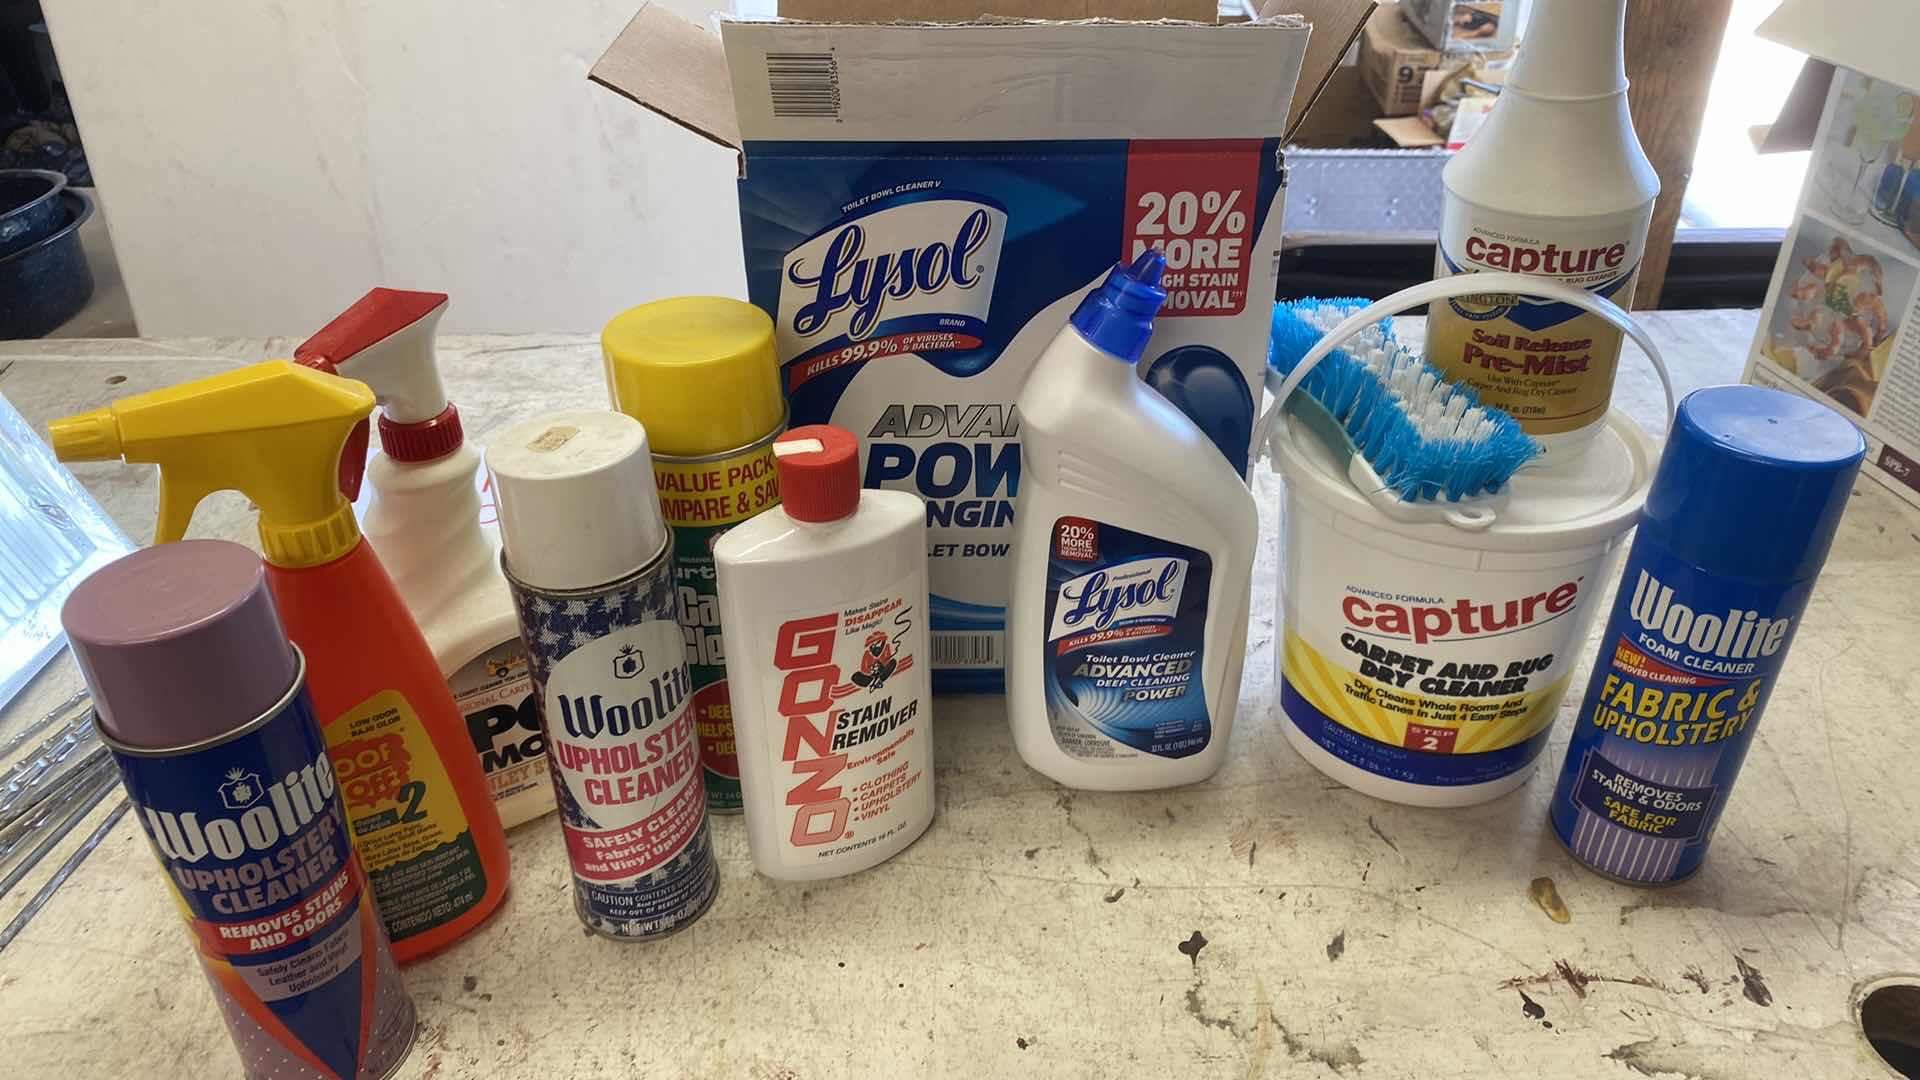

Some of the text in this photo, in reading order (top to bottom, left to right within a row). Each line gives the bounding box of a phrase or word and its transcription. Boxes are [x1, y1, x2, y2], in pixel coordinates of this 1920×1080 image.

[842, 195, 870, 213] TOILET
[871, 187, 894, 201] BOWL
[895, 180, 934, 194] CLEANER
[1135, 189, 1247, 236] 20%
[1465, 236, 1627, 274] capture
[788, 208, 992, 341] Lysol
[1188, 272, 1239, 288] STAIN
[903, 333, 954, 344] OF VIRUSES
[939, 318, 966, 328] BRAND
[1472, 327, 1593, 353] Soil Release
[807, 339, 898, 376] KILLS 99.9%
[1461, 342, 1591, 376] Pre-Mist
[654, 453, 774, 493] VALUE PACK
[863, 442, 1022, 499] POW
[659, 477, 779, 522] MPARE & SAV
[926, 500, 1015, 529] NGIN
[1060, 525, 1095, 541] 20%
[1060, 538, 1093, 549] MORE
[962, 543, 1011, 558] BOW
[843, 598, 889, 618] Makes Stains
[1063, 560, 1179, 630] Lysol
[1345, 584, 1445, 605] ADVANCED FORMULA
[844, 598, 904, 628] DISAPPEAR
[845, 618, 884, 636] Like Magic!
[1342, 581, 1578, 645] capture
[1630, 568, 1790, 660] Woolite
[1068, 629, 1125, 647] KILLS 99.9%
[1638, 632, 1756, 675] FOAM CLEANER
[1072, 659, 1193, 679] ADVANCED
[1085, 650, 1196, 664] Toilet Bowl Cleaner
[1340, 632, 1555, 681] CARPET AND RUG
[1612, 659, 1698, 686] IMPROVED CLEANING
[1615, 646, 1647, 668] NEW!
[1095, 673, 1190, 688] DEEP CLEANING
[1123, 685, 1187, 702] POWER
[1359, 658, 1530, 698] DRY CLEANER
[557, 660, 690, 740] Woolite
[708, 703, 732, 721] DEE
[1344, 684, 1528, 723] Traffic Lanes In Just 4 Easy Steps
[1354, 679, 1524, 713] Dry Cleans Whole Rooms And
[1600, 674, 1762, 722] FABRIC &
[350, 707, 399, 730] LOW ODOR
[831, 699, 919, 751] REMOVER
[836, 695, 893, 731] STAIN
[1592, 704, 1753, 747] UPHOLSTERY
[773, 612, 852, 848] GONZO
[1410, 727, 1455, 737] STEP
[1421, 735, 1439, 750] 2
[335, 742, 392, 776] OOF
[847, 728, 916, 770] Environmentally
[876, 750, 897, 766] Safe
[584, 742, 694, 806] CLEANER
[859, 760, 910, 792] CLOTHING
[860, 772, 908, 802] CARPETS
[1614, 772, 1685, 803] REMOVES
[396, 780, 429, 825] 2
[861, 772, 923, 812] UPHOLSTERY
[1591, 769, 1703, 813] STAINS & ODORS
[144, 751, 336, 864] Woolite
[861, 805, 891, 822] VINYL
[1602, 796, 1678, 828] SAFE FOR
[1608, 810, 1665, 835] FABRIC
[175, 800, 342, 891] UPHOLSTERY
[582, 826, 644, 849] SAFELY
[596, 840, 651, 861] Fabric,
[817, 849, 835, 860] NET
[836, 836, 878, 856] CONTENTS
[584, 852, 651, 873] and Vinyl
[211, 846, 338, 915] CLEANER
[591, 889, 634, 907] CAUTION
[634, 882, 676, 902] CONTENTS
[219, 906, 302, 940] REMOVES
[303, 871, 350, 918] STAINS
[628, 908, 644, 917] OUT
[646, 906, 655, 915] OF
[250, 900, 343, 951] AND ODORS
[256, 962, 290, 979] Safely
[290, 946, 322, 970] Cleans
[267, 966, 309, 988] Leather
[288, 962, 340, 993] Upholstery
